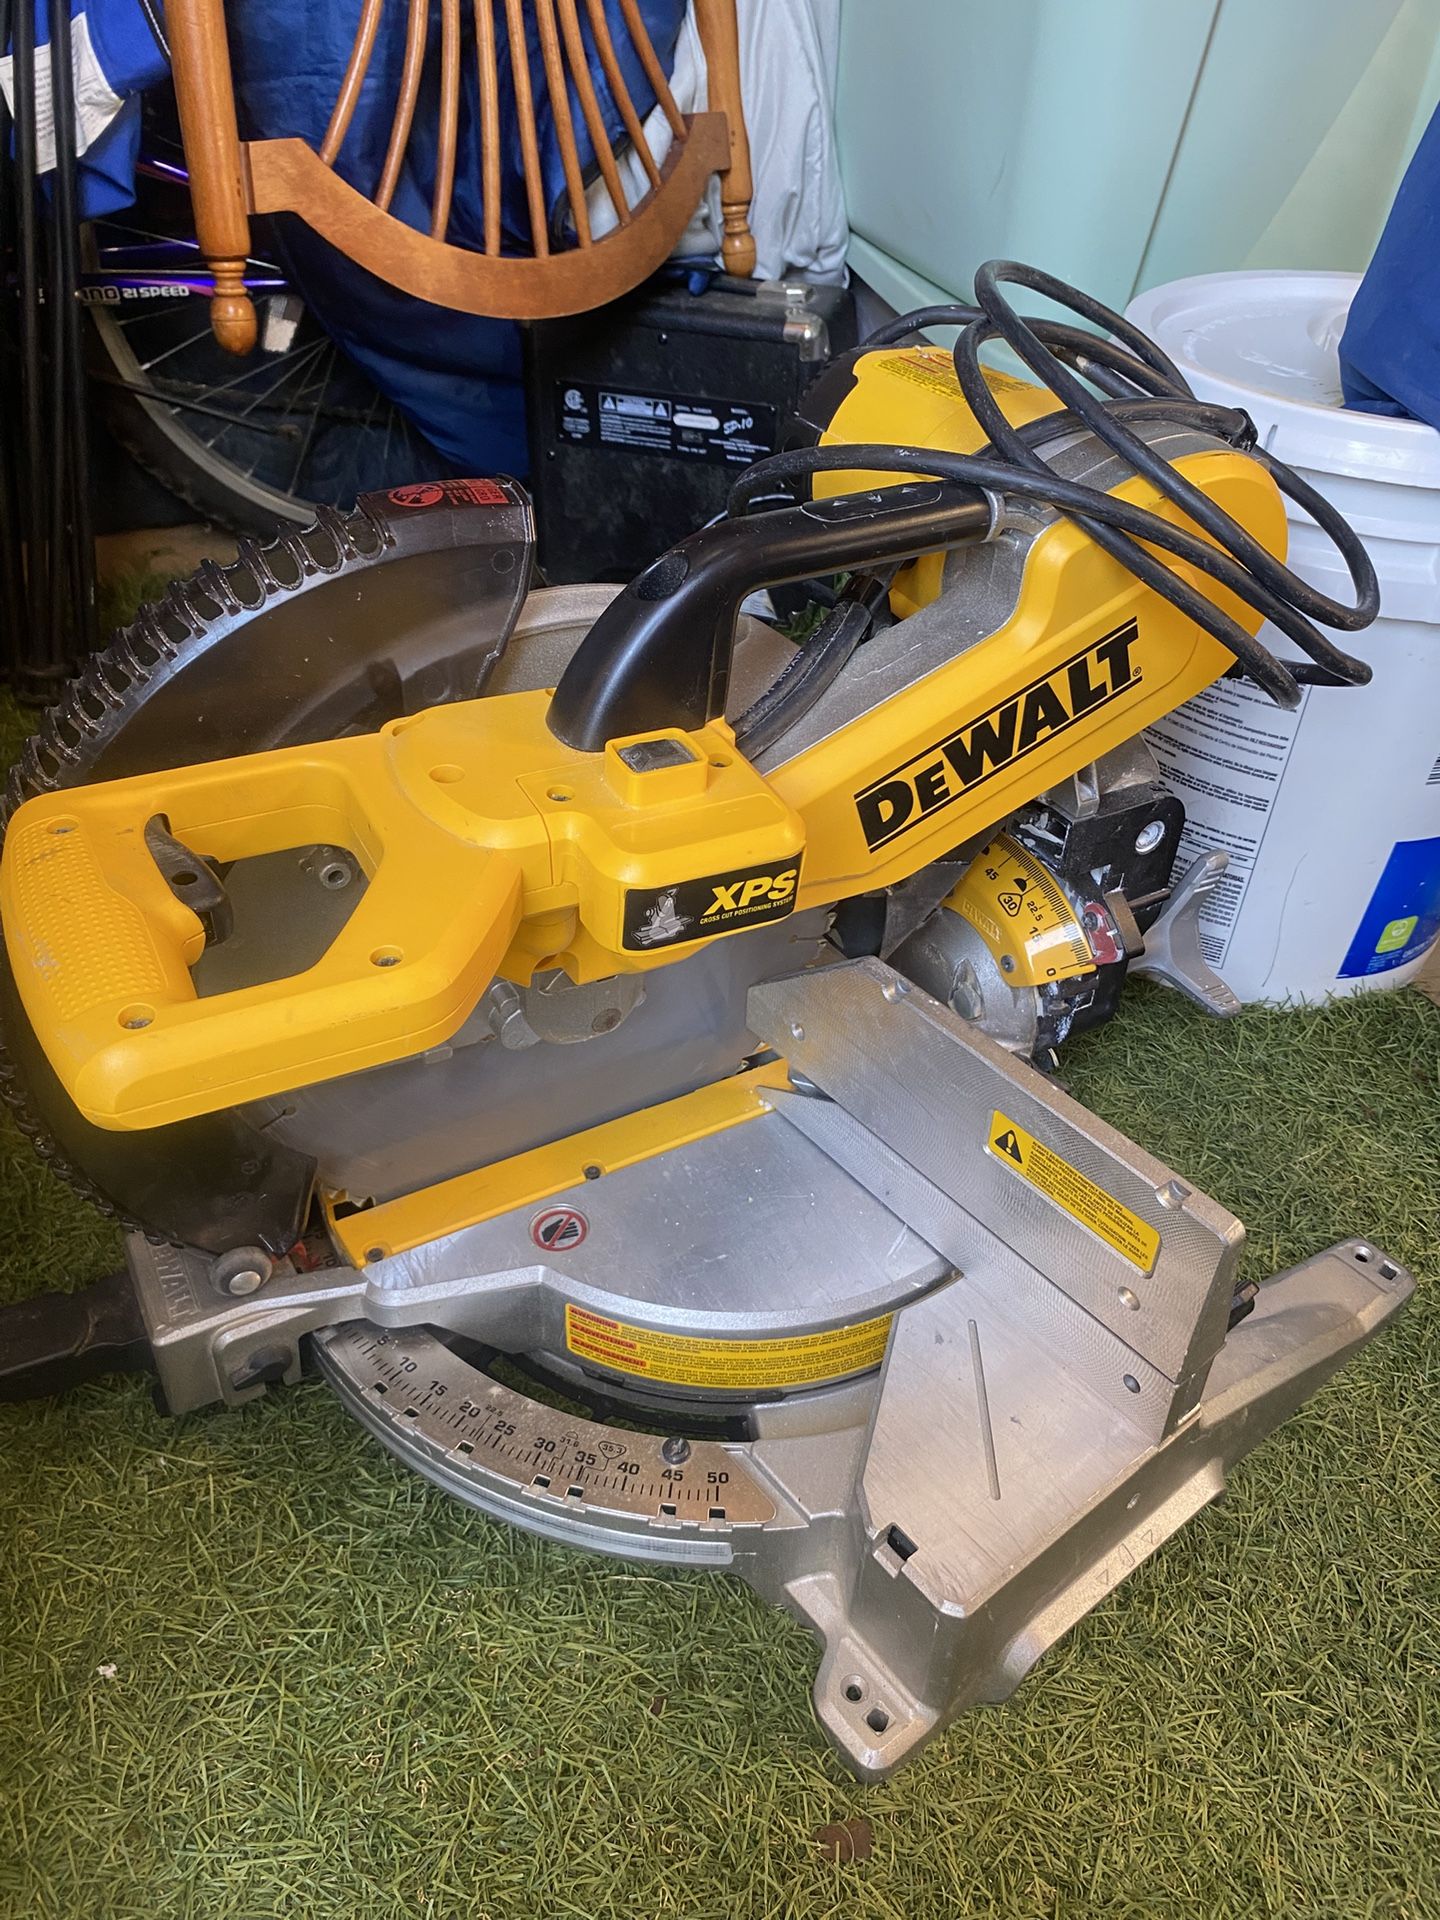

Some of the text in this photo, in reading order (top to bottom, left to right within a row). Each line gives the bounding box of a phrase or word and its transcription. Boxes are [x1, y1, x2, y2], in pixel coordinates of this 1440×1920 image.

[122, 288, 138, 299] 21
[140, 286, 190, 298] SPEED
[855, 624, 1139, 848] DEWALT
[985, 868, 1000, 881] 45
[702, 869, 797, 916] XPS
[1003, 896, 1018, 911] 30
[1026, 900, 1044, 922] 22.5
[700, 914, 720, 925] CROSS
[721, 911, 733, 920] CUT
[734, 902, 772, 916] POSITIONING
[1028, 926, 1044, 944] 15
[1046, 968, 1056, 977] 0
[377, 1335, 730, 1484] 5 10 15 20 25 30 35 40 45 50
[485, 1404, 504, 1416] 22.5
[601, 1443, 622, 1454] 35.3
